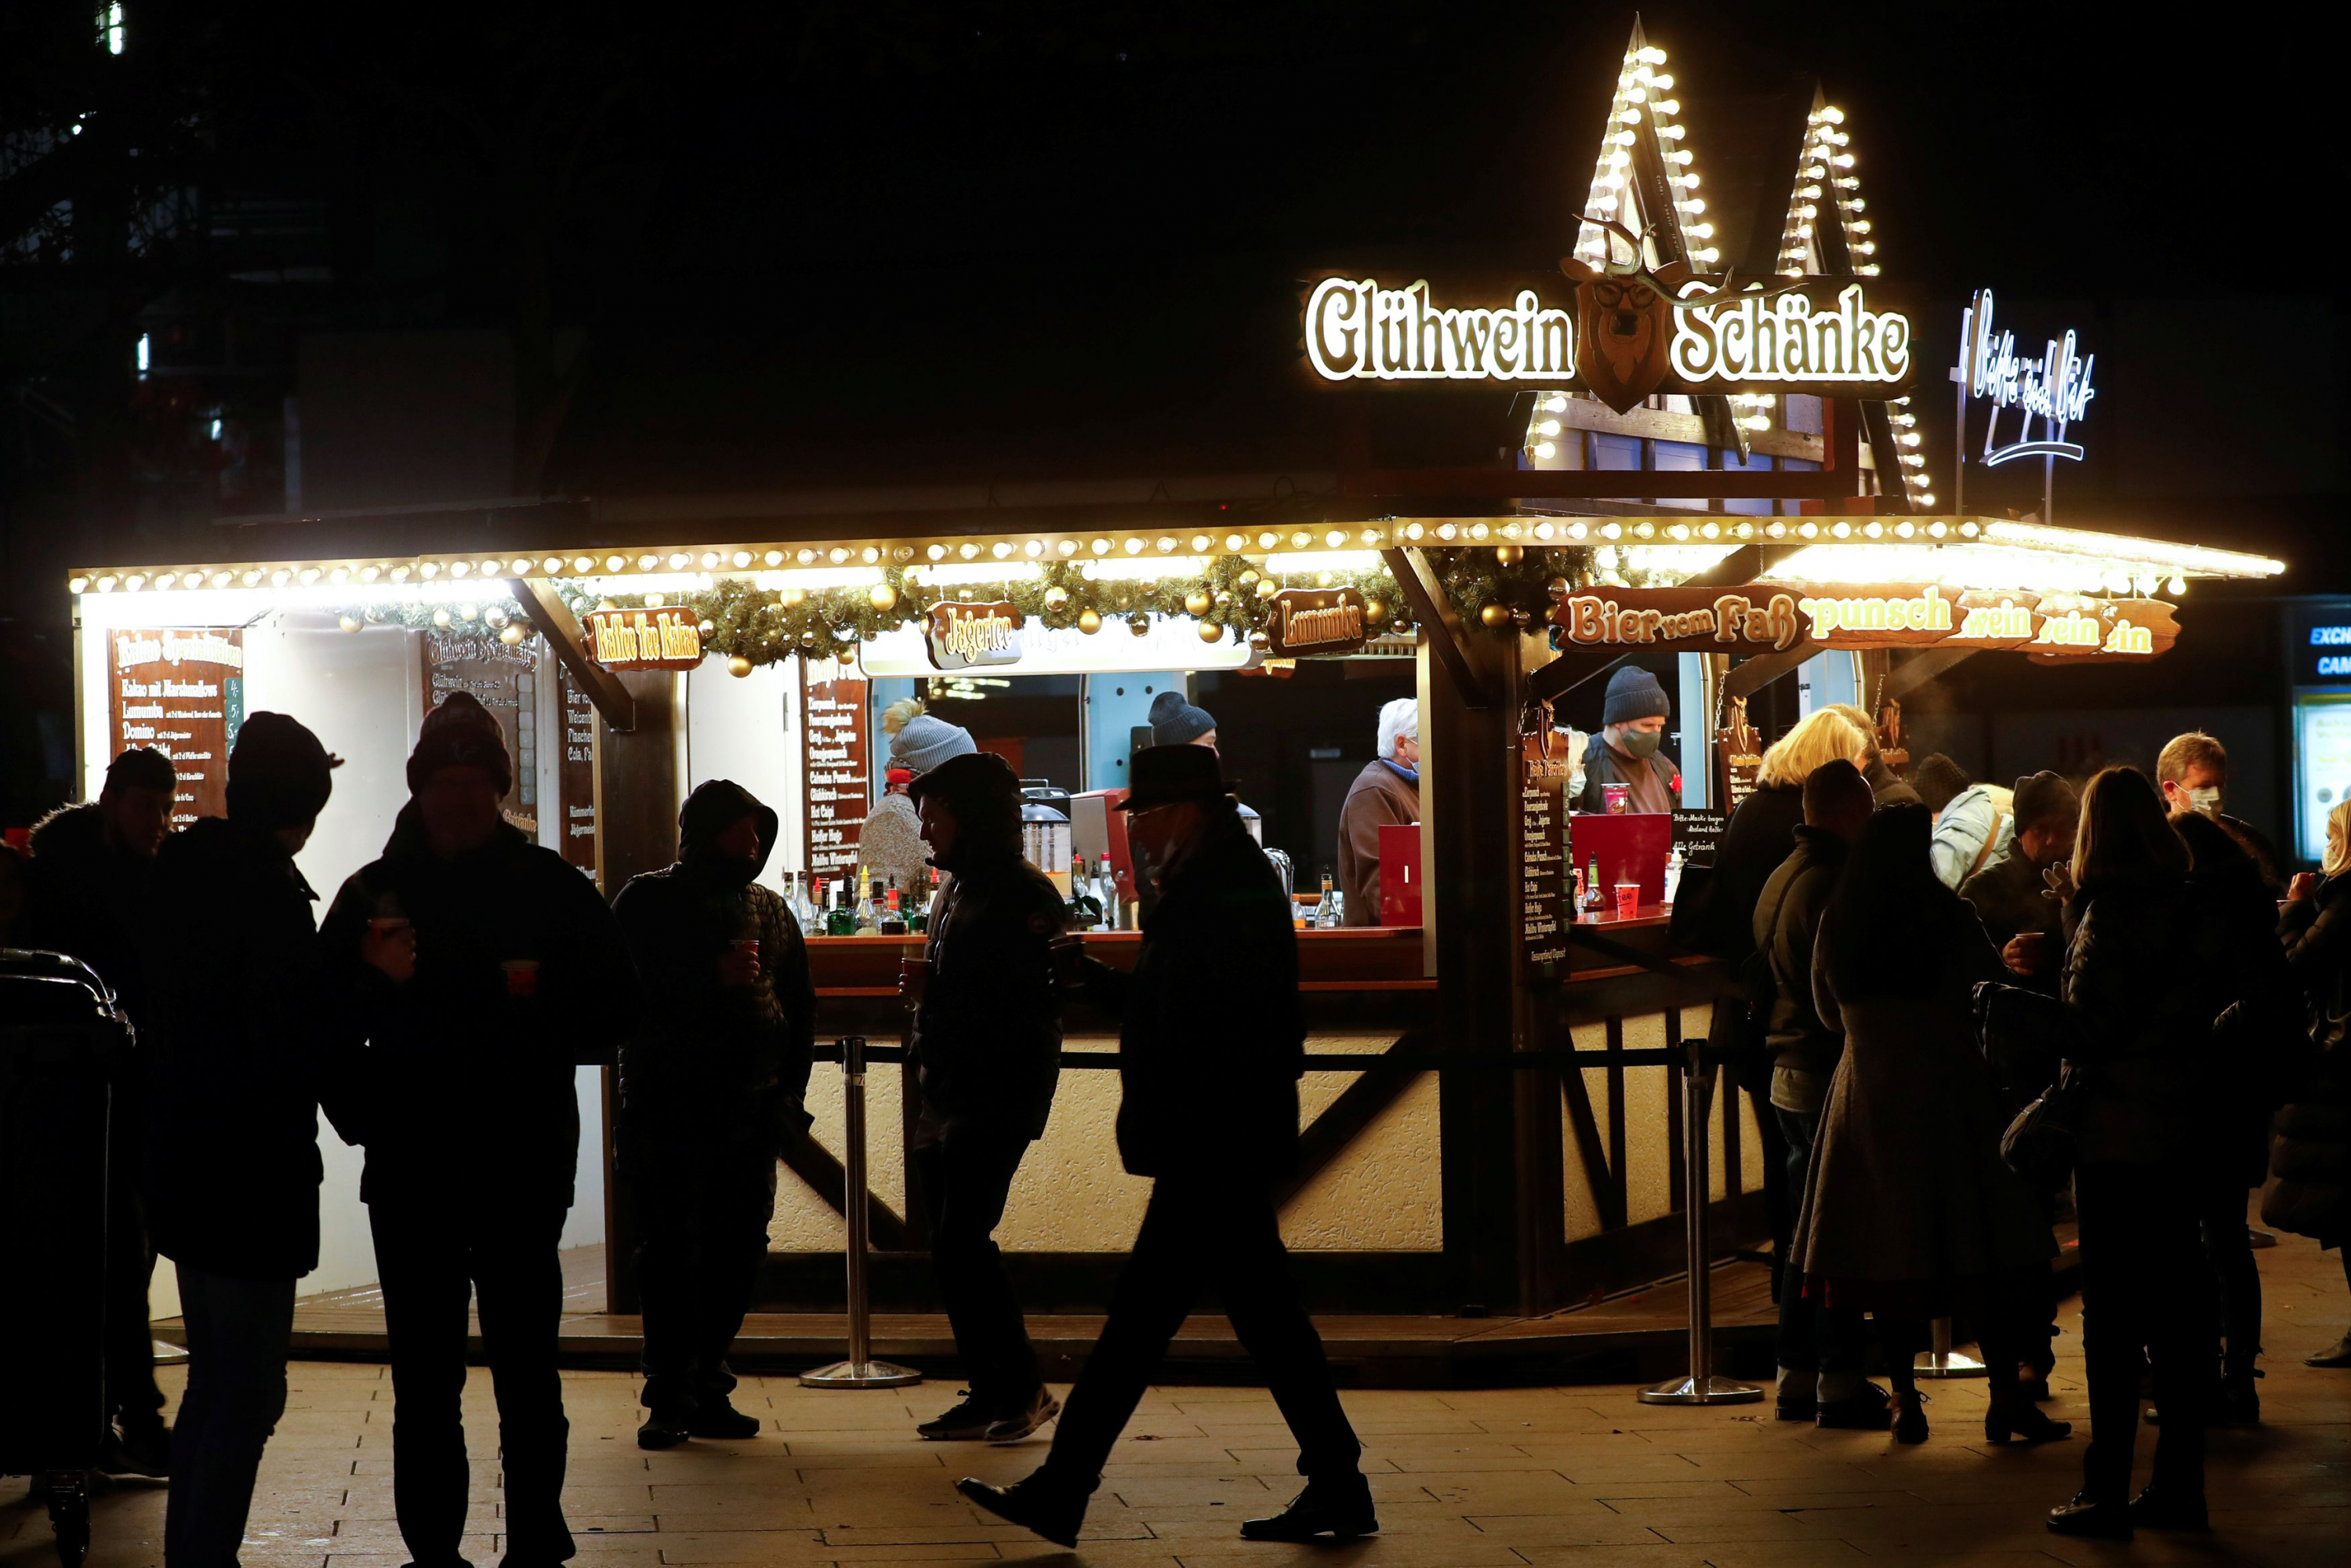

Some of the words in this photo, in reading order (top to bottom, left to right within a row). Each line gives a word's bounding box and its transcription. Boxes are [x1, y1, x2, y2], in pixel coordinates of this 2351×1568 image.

[1305, 278, 1576, 382] Glühwein
[1669, 280, 1911, 382] Schänke
[593, 613, 637, 662] Kaffee
[635, 613, 660, 660] Tee
[657, 612, 700, 659] Kakao
[1281, 593, 1362, 647] Lumumba
[1568, 595, 1663, 644] Bier
[1661, 608, 1716, 640] vom
[1714, 593, 1798, 651] Faß
[117, 634, 161, 668] Kakao
[122, 678, 147, 697] Kakao
[148, 681, 161, 697] mit
[163, 679, 218, 697] Marshmallows
[122, 700, 164, 719] Lumumba
[123, 721, 155, 739] Domino
[1689, 840, 1715, 856] Getränk
